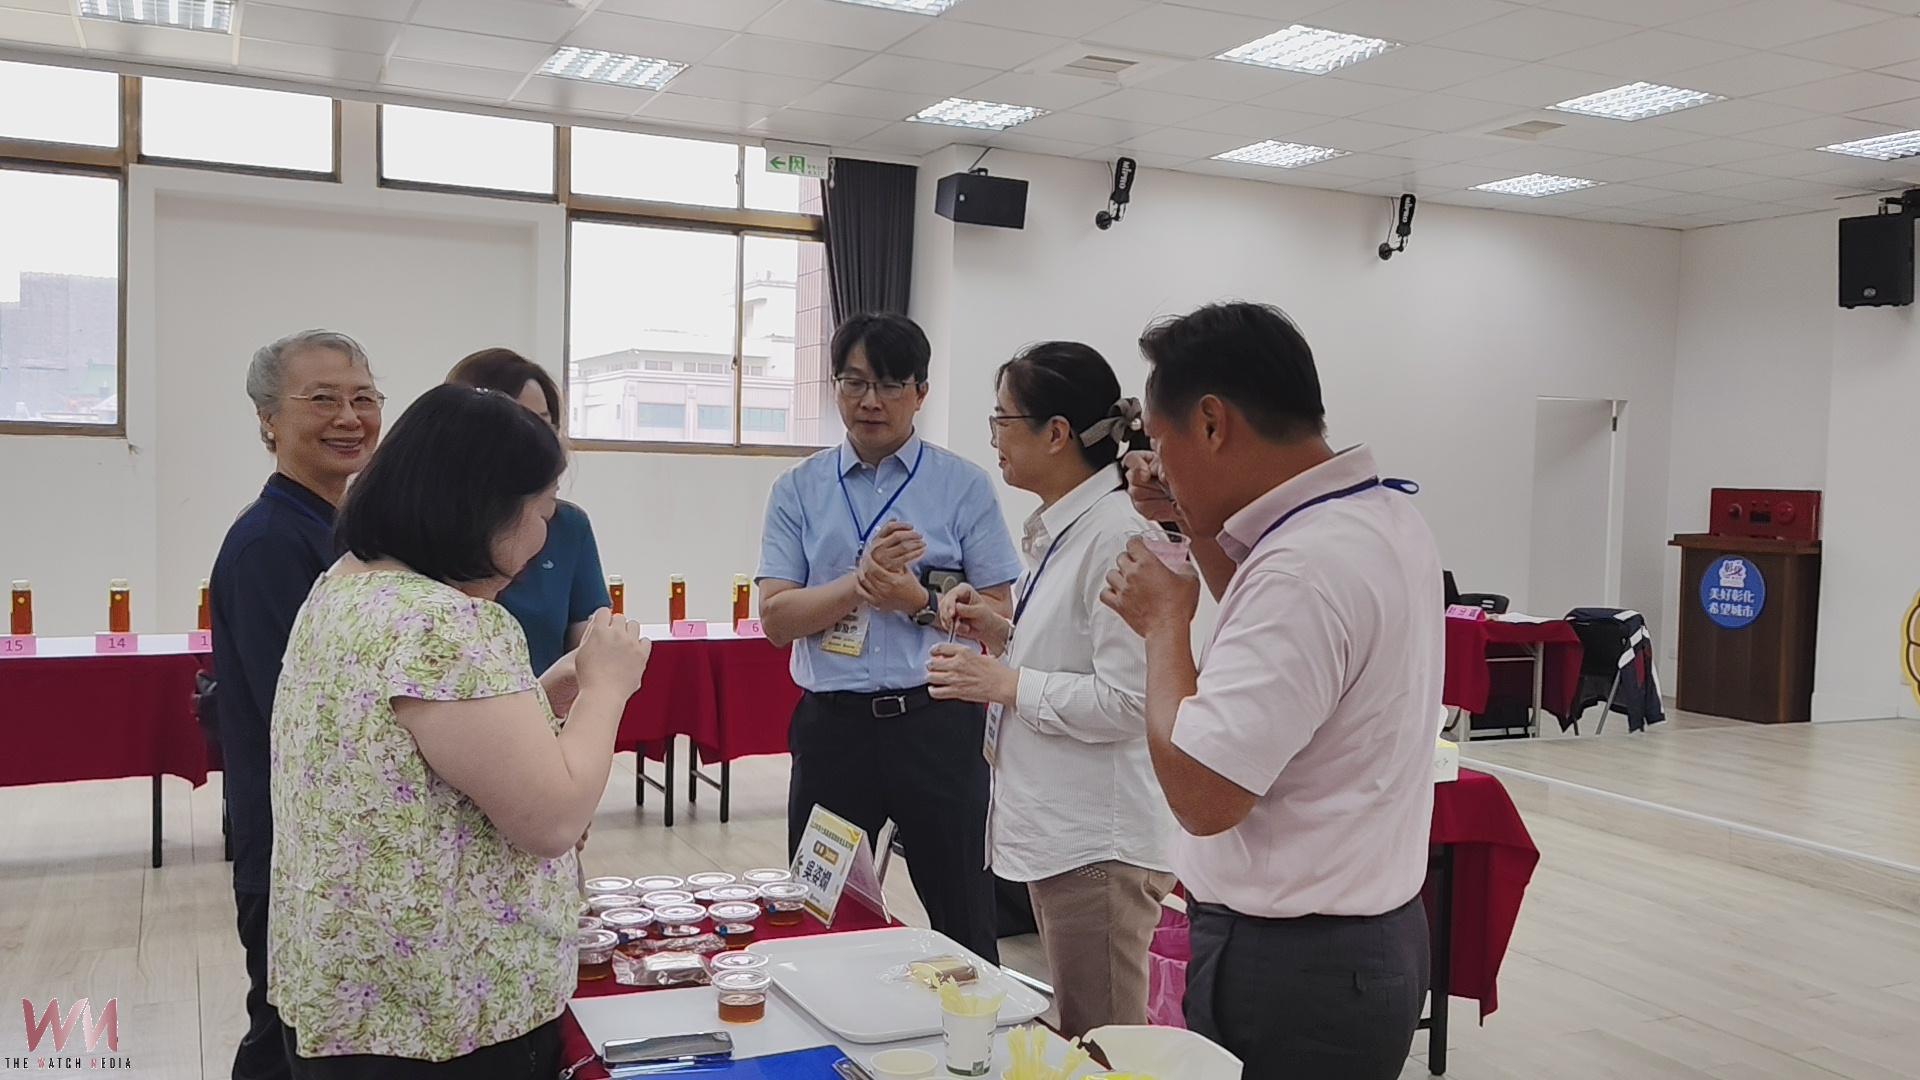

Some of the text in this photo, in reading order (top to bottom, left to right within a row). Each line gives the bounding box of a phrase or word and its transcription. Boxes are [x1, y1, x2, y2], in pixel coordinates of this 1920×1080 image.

[1708, 587, 1755, 603] 美好彰化
[1708, 602, 1754, 617] 希望城市
[688, 624, 694, 633] 7
[752, 623, 759, 632] 6
[5, 640, 23, 651] 15
[108, 638, 126, 649] 14
